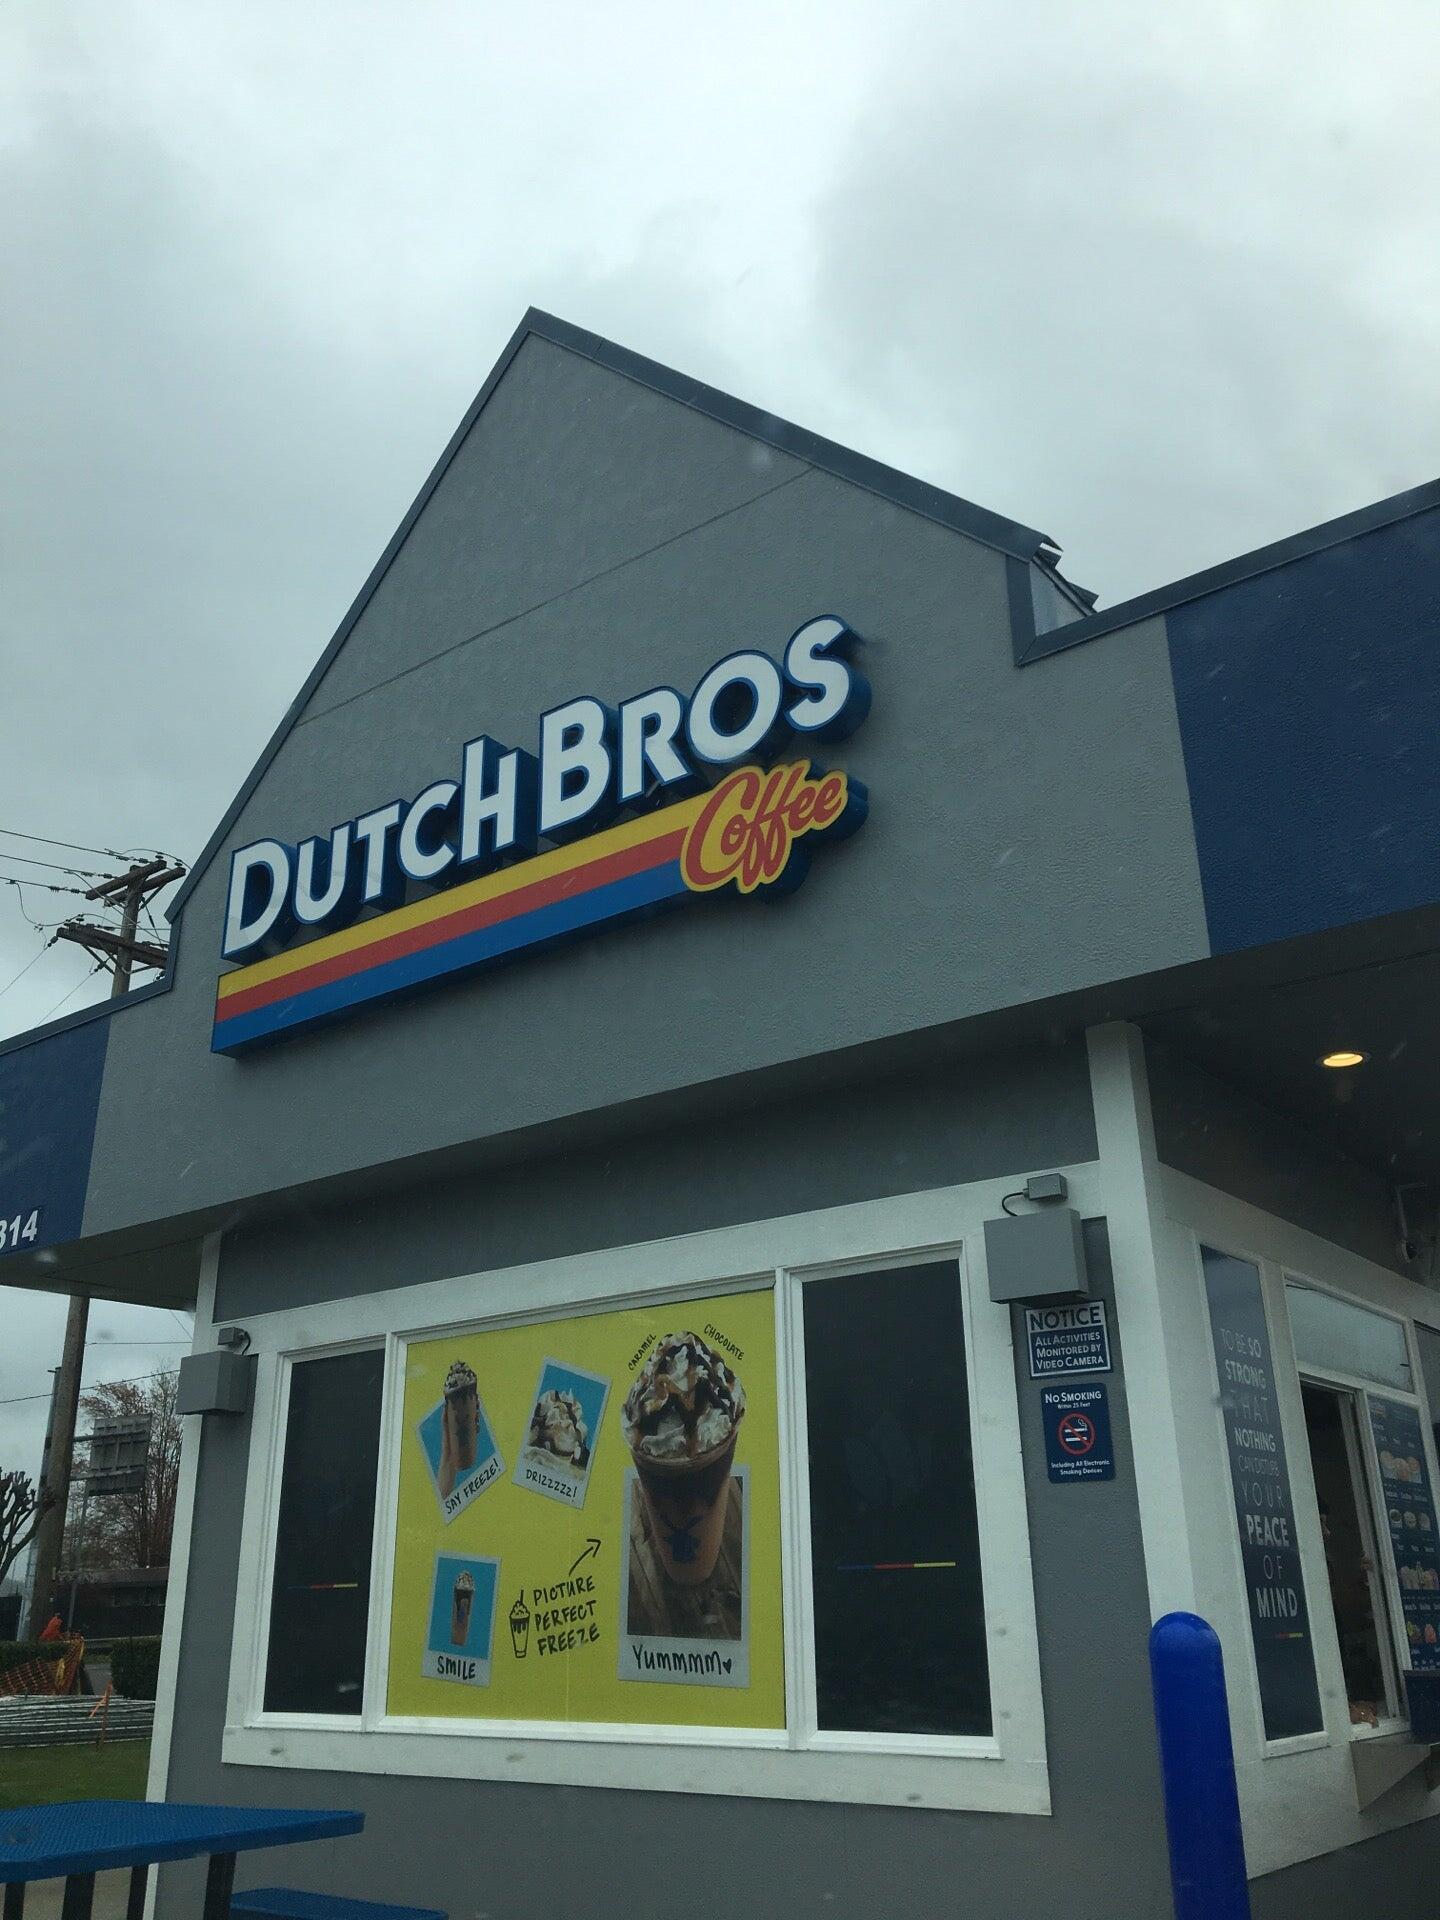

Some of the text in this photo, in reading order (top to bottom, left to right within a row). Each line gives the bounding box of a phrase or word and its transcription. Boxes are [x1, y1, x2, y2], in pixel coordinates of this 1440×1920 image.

[221, 615, 853, 959] DUTCH BROS
[682, 761, 847, 893] Coffee
[1030, 1306, 1101, 1331] NOTICE
[628, 1333, 657, 1371] CARAMEL
[703, 1323, 745, 1361] CHOCOLATE
[1035, 1332, 1101, 1347] ALL ACTIVITIES
[1036, 1343, 1102, 1358] MONITORED BY
[1220, 1328, 1262, 1358] TO BE SO
[1036, 1355, 1104, 1370] VIDEO CAMERA
[1225, 1359, 1267, 1390] STRONG
[1061, 1391, 1102, 1402] SMOKING
[1230, 1388, 1270, 1425] THAT
[1233, 1426, 1276, 1453] NOTHING
[445, 1457, 501, 1515] SAY FREEZE!
[1241, 1480, 1286, 1510] YOUR
[1245, 1514, 1290, 1548] PEACE
[1263, 1554, 1284, 1580] OF
[533, 1575, 596, 1606] PICTURE
[1255, 1587, 1299, 1618] MIND
[534, 1599, 598, 1632] PERFECT
[536, 1622, 601, 1657] FREEZE
[436, 1656, 477, 1681] SMILE
